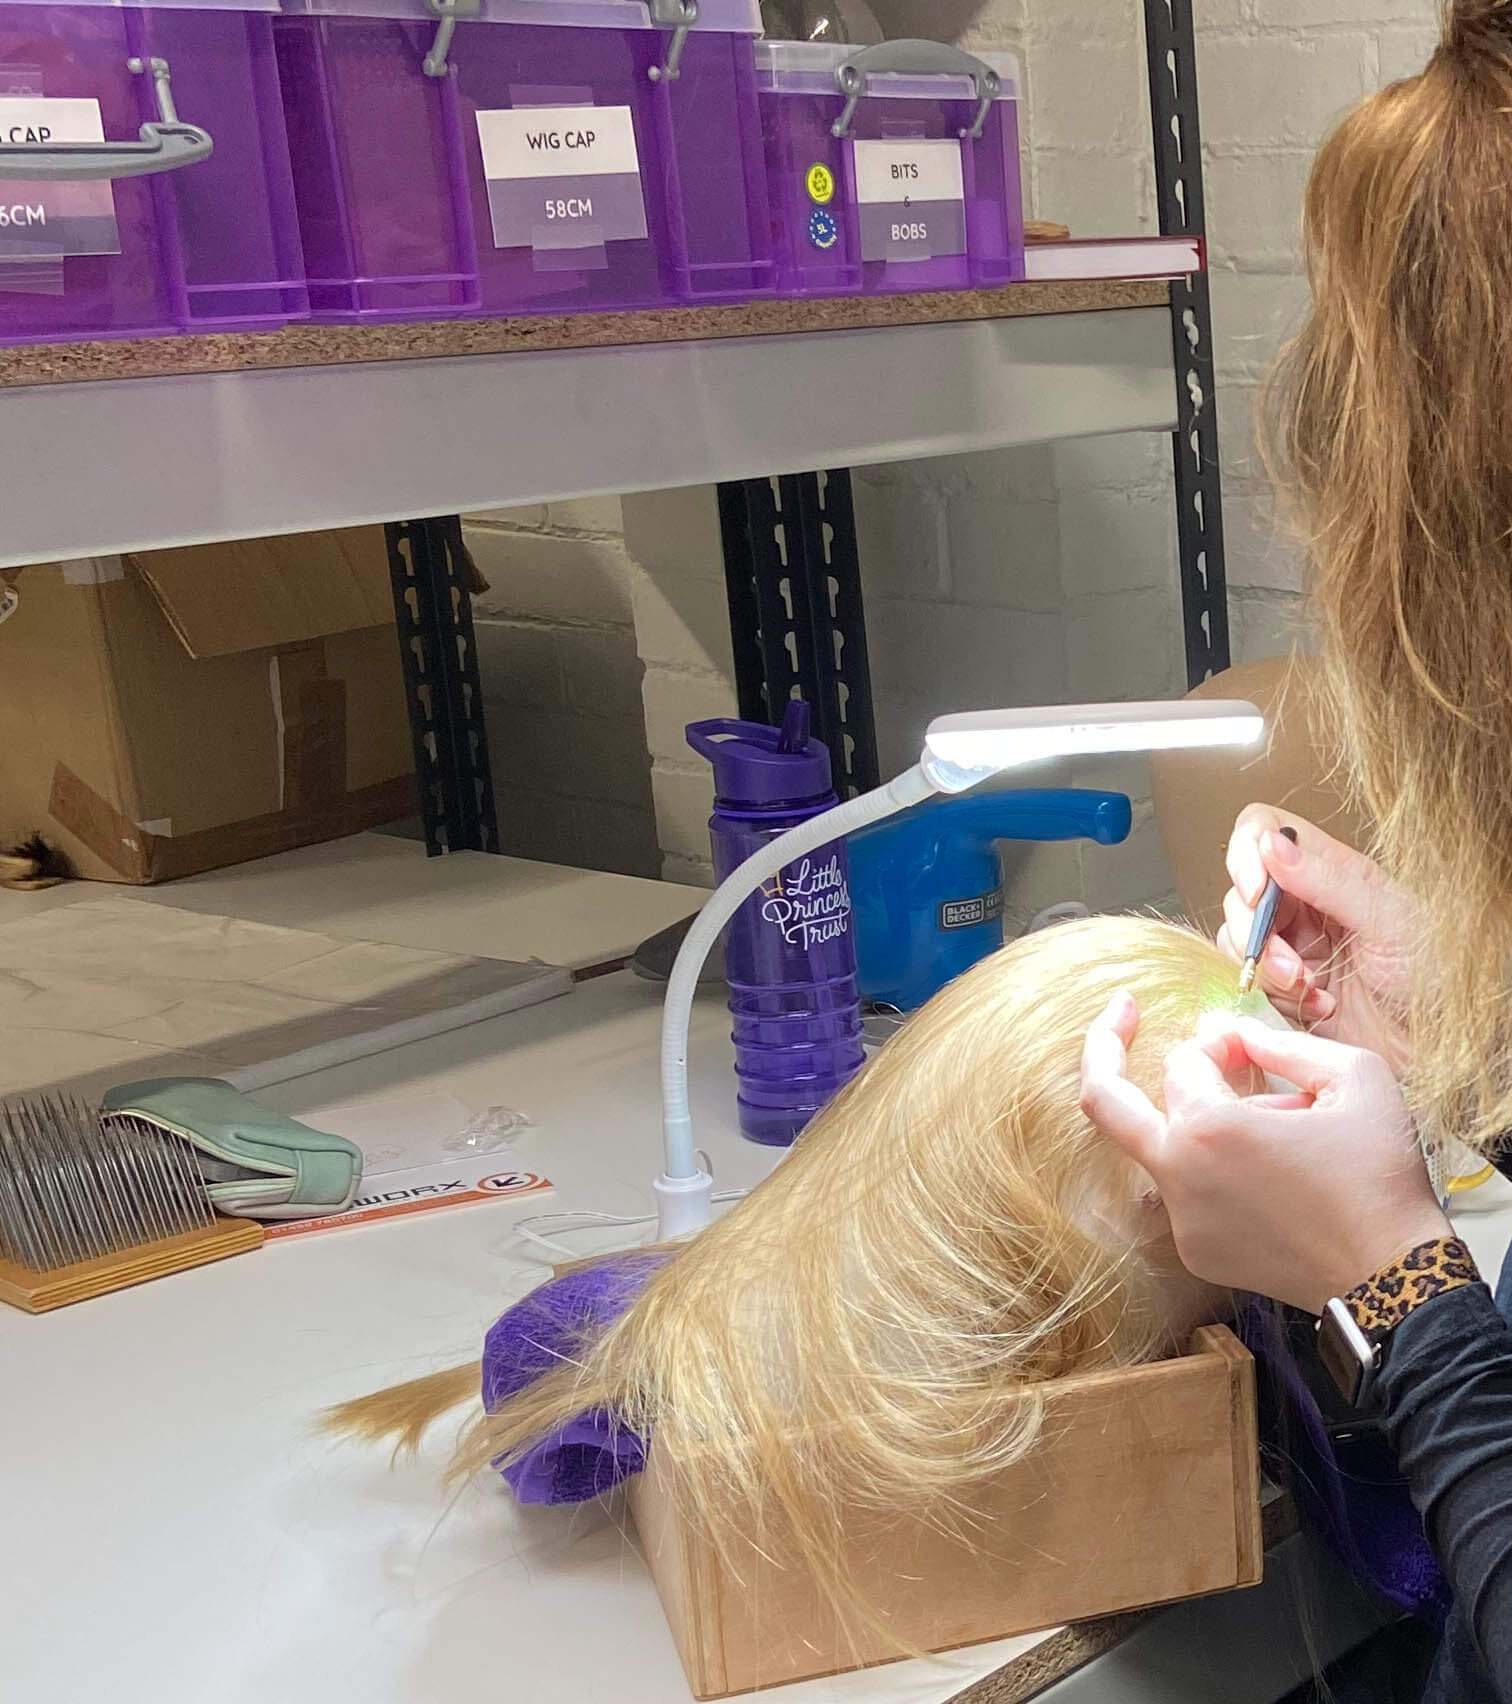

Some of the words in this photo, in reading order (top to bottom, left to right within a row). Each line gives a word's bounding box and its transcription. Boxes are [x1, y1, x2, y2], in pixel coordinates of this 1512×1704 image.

[9, 127, 51, 143] CAP
[526, 131, 561, 150] WIG
[565, 130, 596, 149] CAP
[890, 163, 919, 180] BITS
[545, 198, 593, 219] 58CM
[890, 223, 927, 241] BOBS
[786, 854, 842, 896] Little
[762, 881, 851, 935] Princess
[785, 908, 848, 951] Trust
[349, 1179, 467, 1208] WORX
